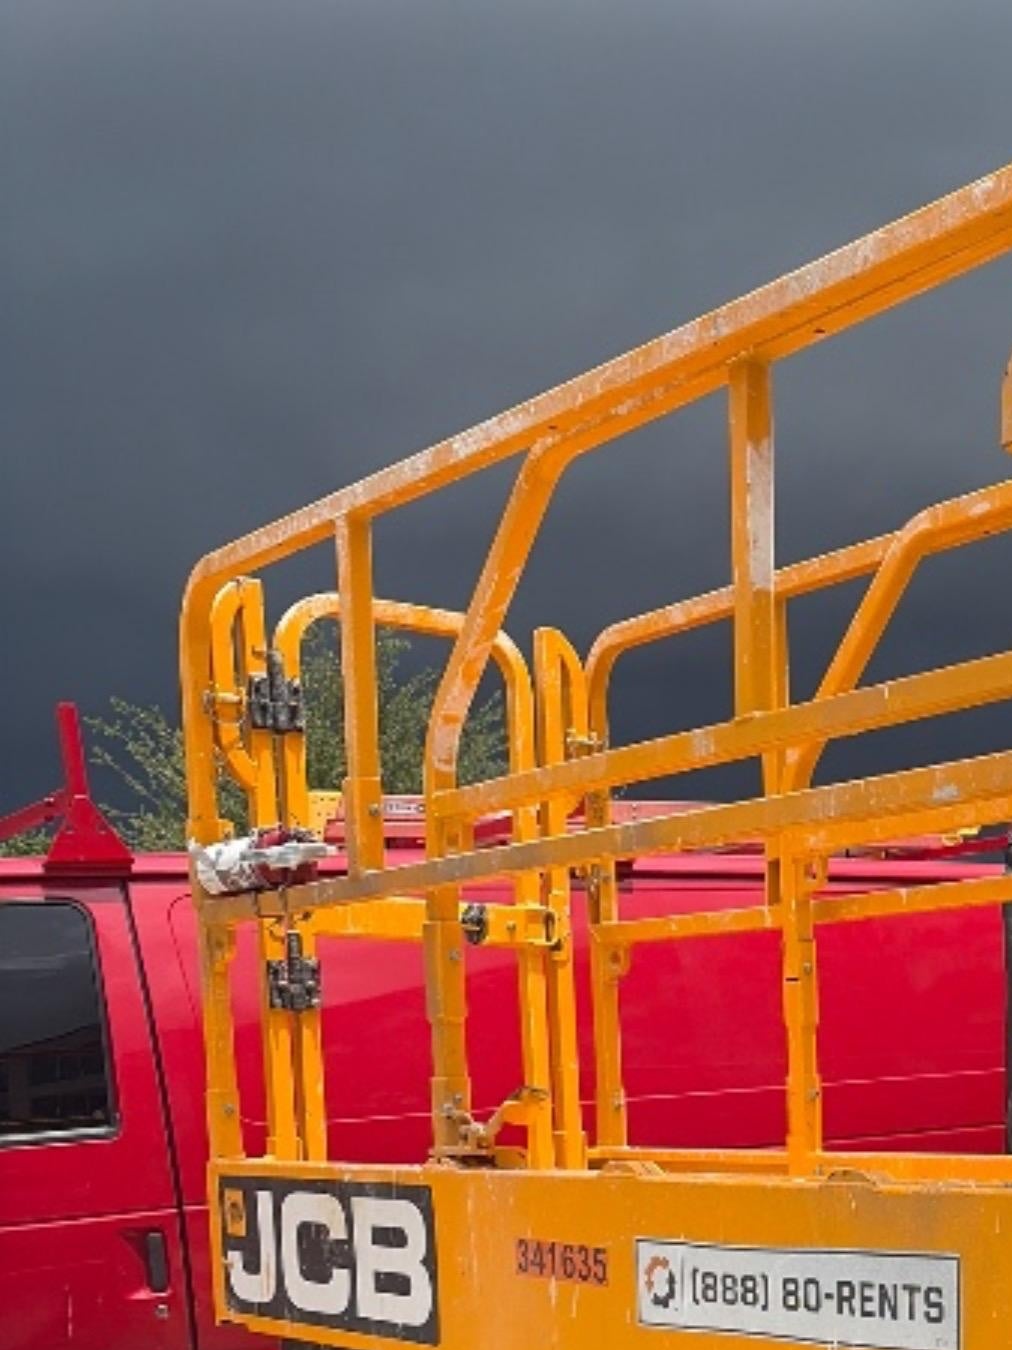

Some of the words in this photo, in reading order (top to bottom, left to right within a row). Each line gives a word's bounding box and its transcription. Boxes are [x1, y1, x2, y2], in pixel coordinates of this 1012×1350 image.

[227, 1190, 433, 1326] JCB
[517, 1238, 607, 1285] 341635
[692, 1267, 768, 1311] (888)
[782, 1276, 944, 1324] 80-RENTS
